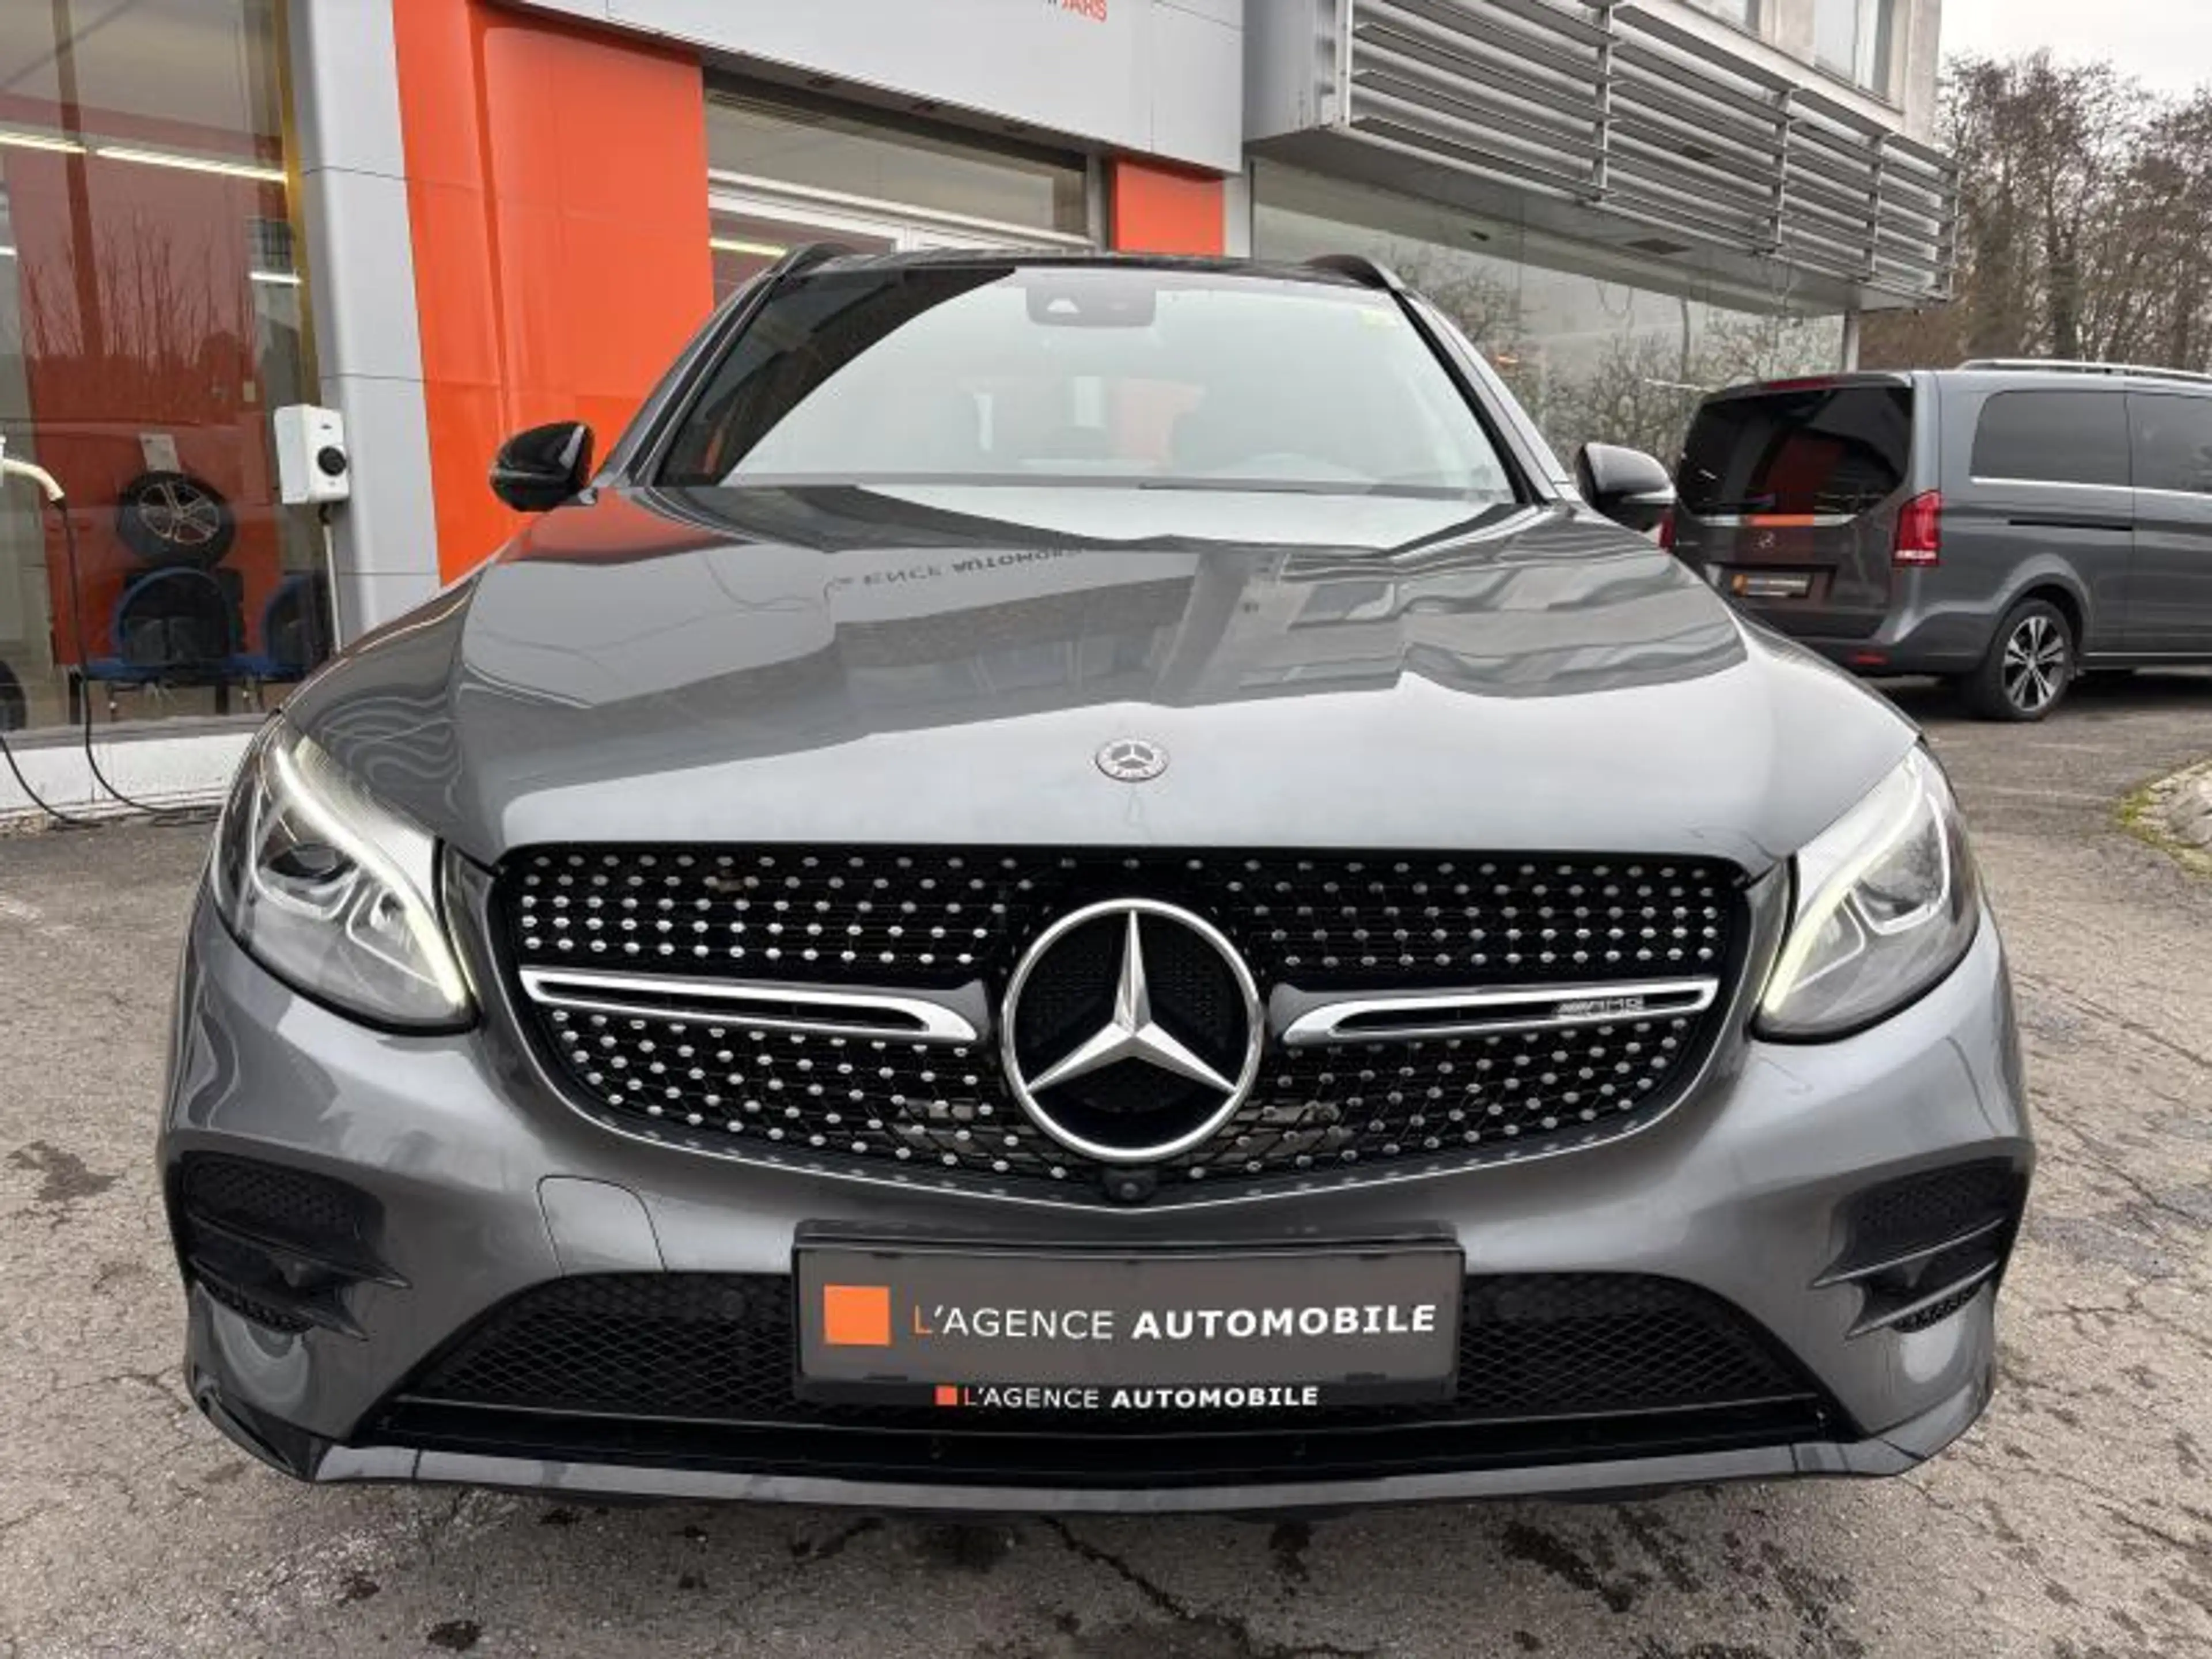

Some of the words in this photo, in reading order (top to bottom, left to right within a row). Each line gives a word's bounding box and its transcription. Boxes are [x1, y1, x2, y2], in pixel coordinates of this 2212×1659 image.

[914, 1305, 1114, 1340] L'AGENCE
[1131, 1304, 1437, 1339] AUTOMOBILE
[964, 1386, 1099, 1408] L'AGENCE
[1111, 1386, 1320, 1408] AUTOMOBILE
